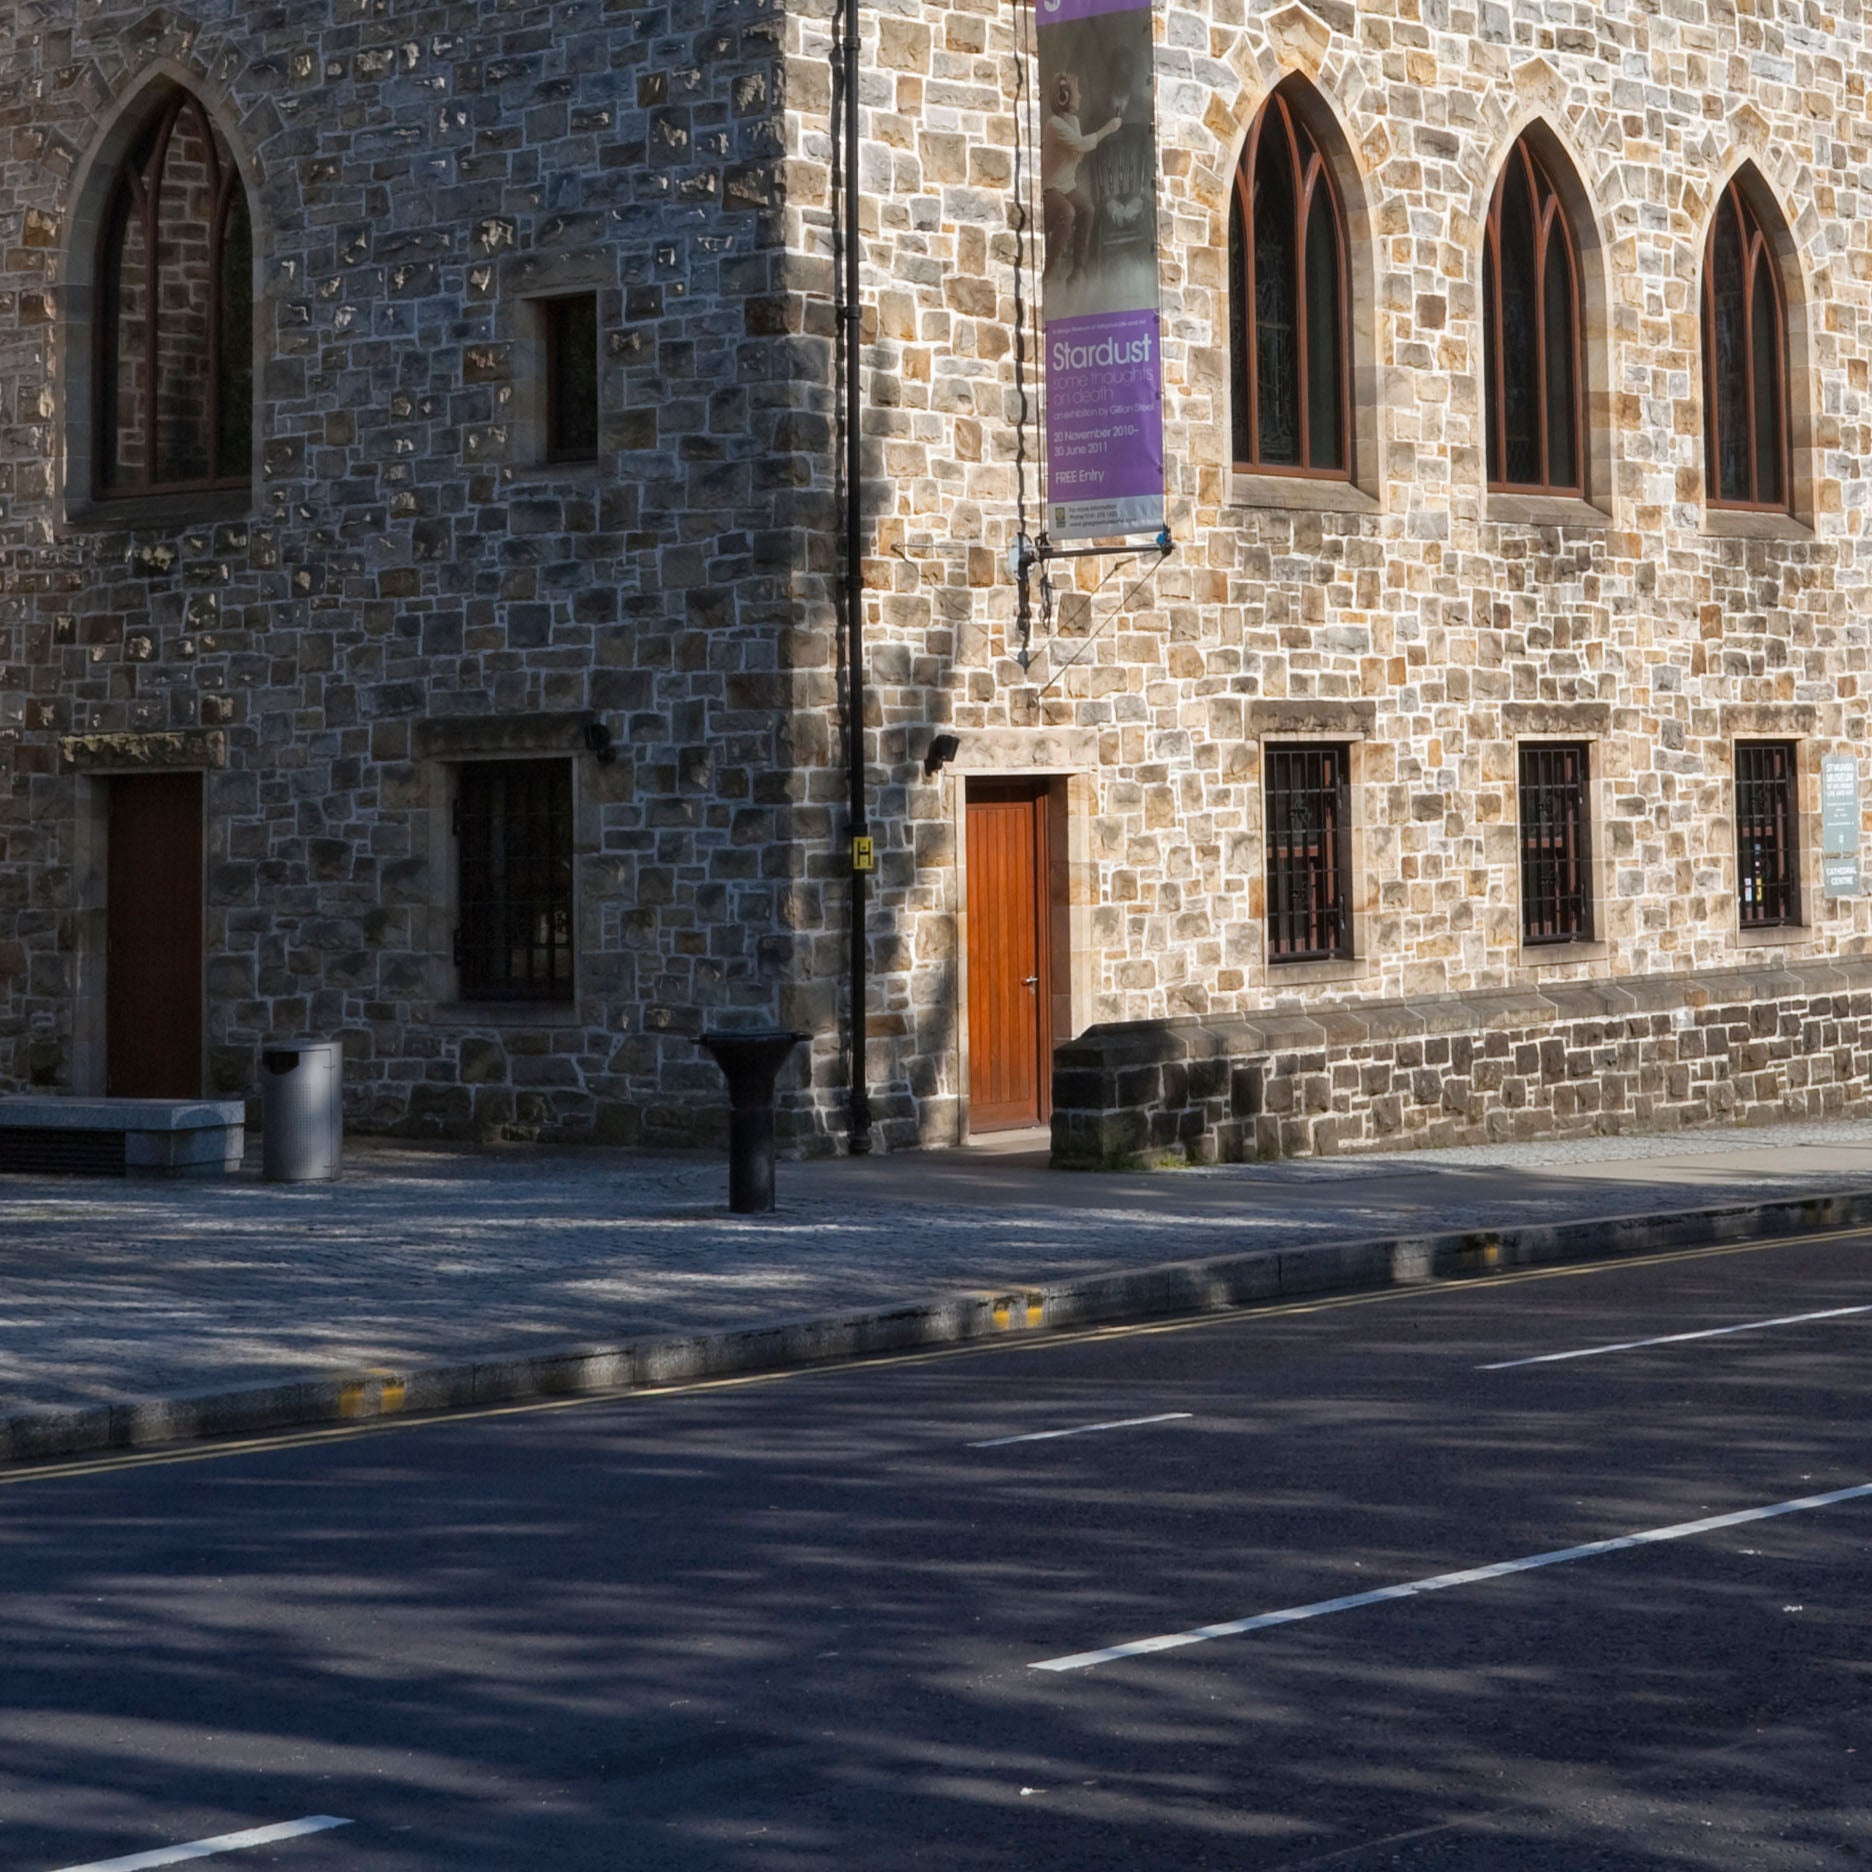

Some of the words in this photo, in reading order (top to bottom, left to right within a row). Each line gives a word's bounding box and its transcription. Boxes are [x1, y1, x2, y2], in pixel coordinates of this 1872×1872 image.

[1052, 333, 1152, 371] Stardust
[1053, 374, 1089, 390] some
[1090, 365, 1154, 384] thoughts
[1054, 392, 1070, 406] on
[1072, 385, 1114, 404] death
[1098, 408, 1108, 417] by
[1053, 432, 1064, 442] 20
[1065, 428, 1111, 441] November
[1054, 446, 1064, 457] 30
[1065, 445, 1087, 456] June
[1088, 441, 1108, 454] 2011
[1055, 470, 1078, 484] FREE
[1079, 468, 1105, 483] Entry
[857, 840, 871, 866] H
[1826, 866, 1857, 876] CATHEDRAL
[1831, 876, 1854, 885] CENTRE
